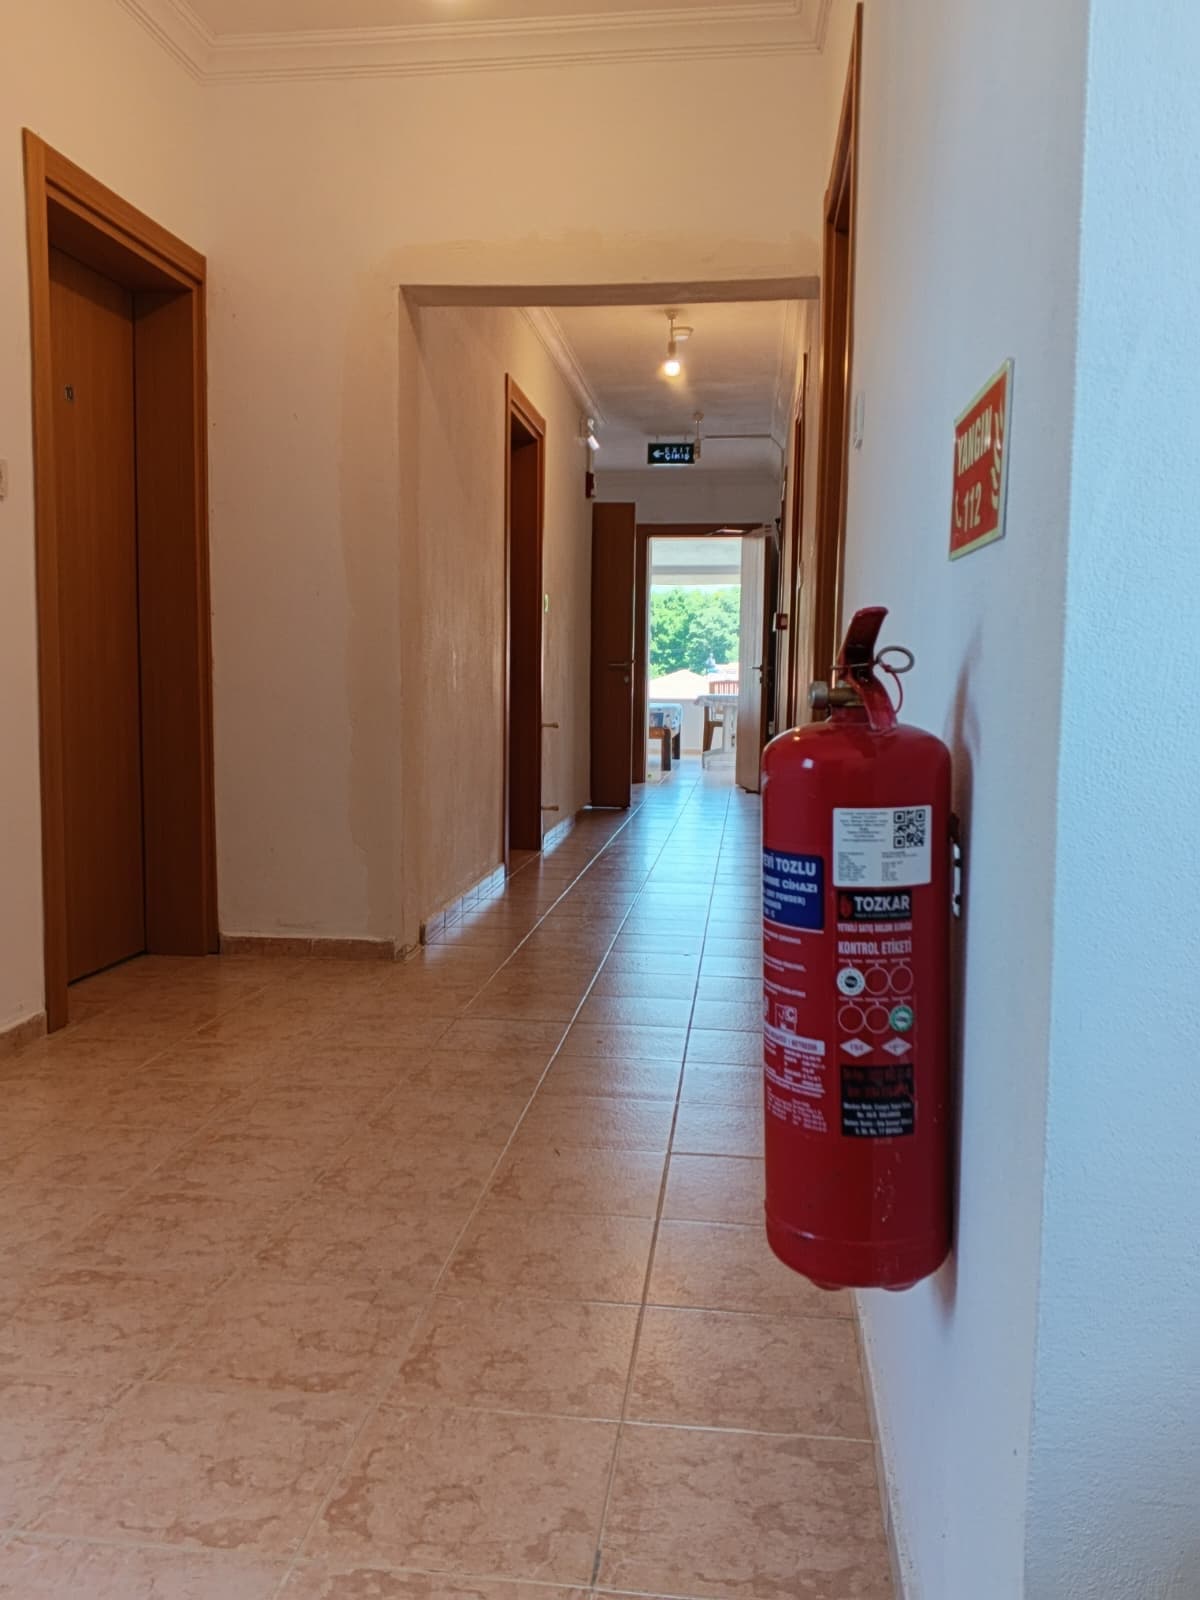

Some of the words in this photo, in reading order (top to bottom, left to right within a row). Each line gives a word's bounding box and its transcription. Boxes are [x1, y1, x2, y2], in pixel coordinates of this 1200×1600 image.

[664, 446, 691, 454] EXIT
[957, 404, 993, 477] YANGIN
[963, 481, 982, 533] 112
[775, 857, 817, 876] TOZLU
[853, 895, 910, 912] TOZKAR
[838, 941, 880, 955] KONTROL
[881, 936, 912, 955] ETİKETİ
